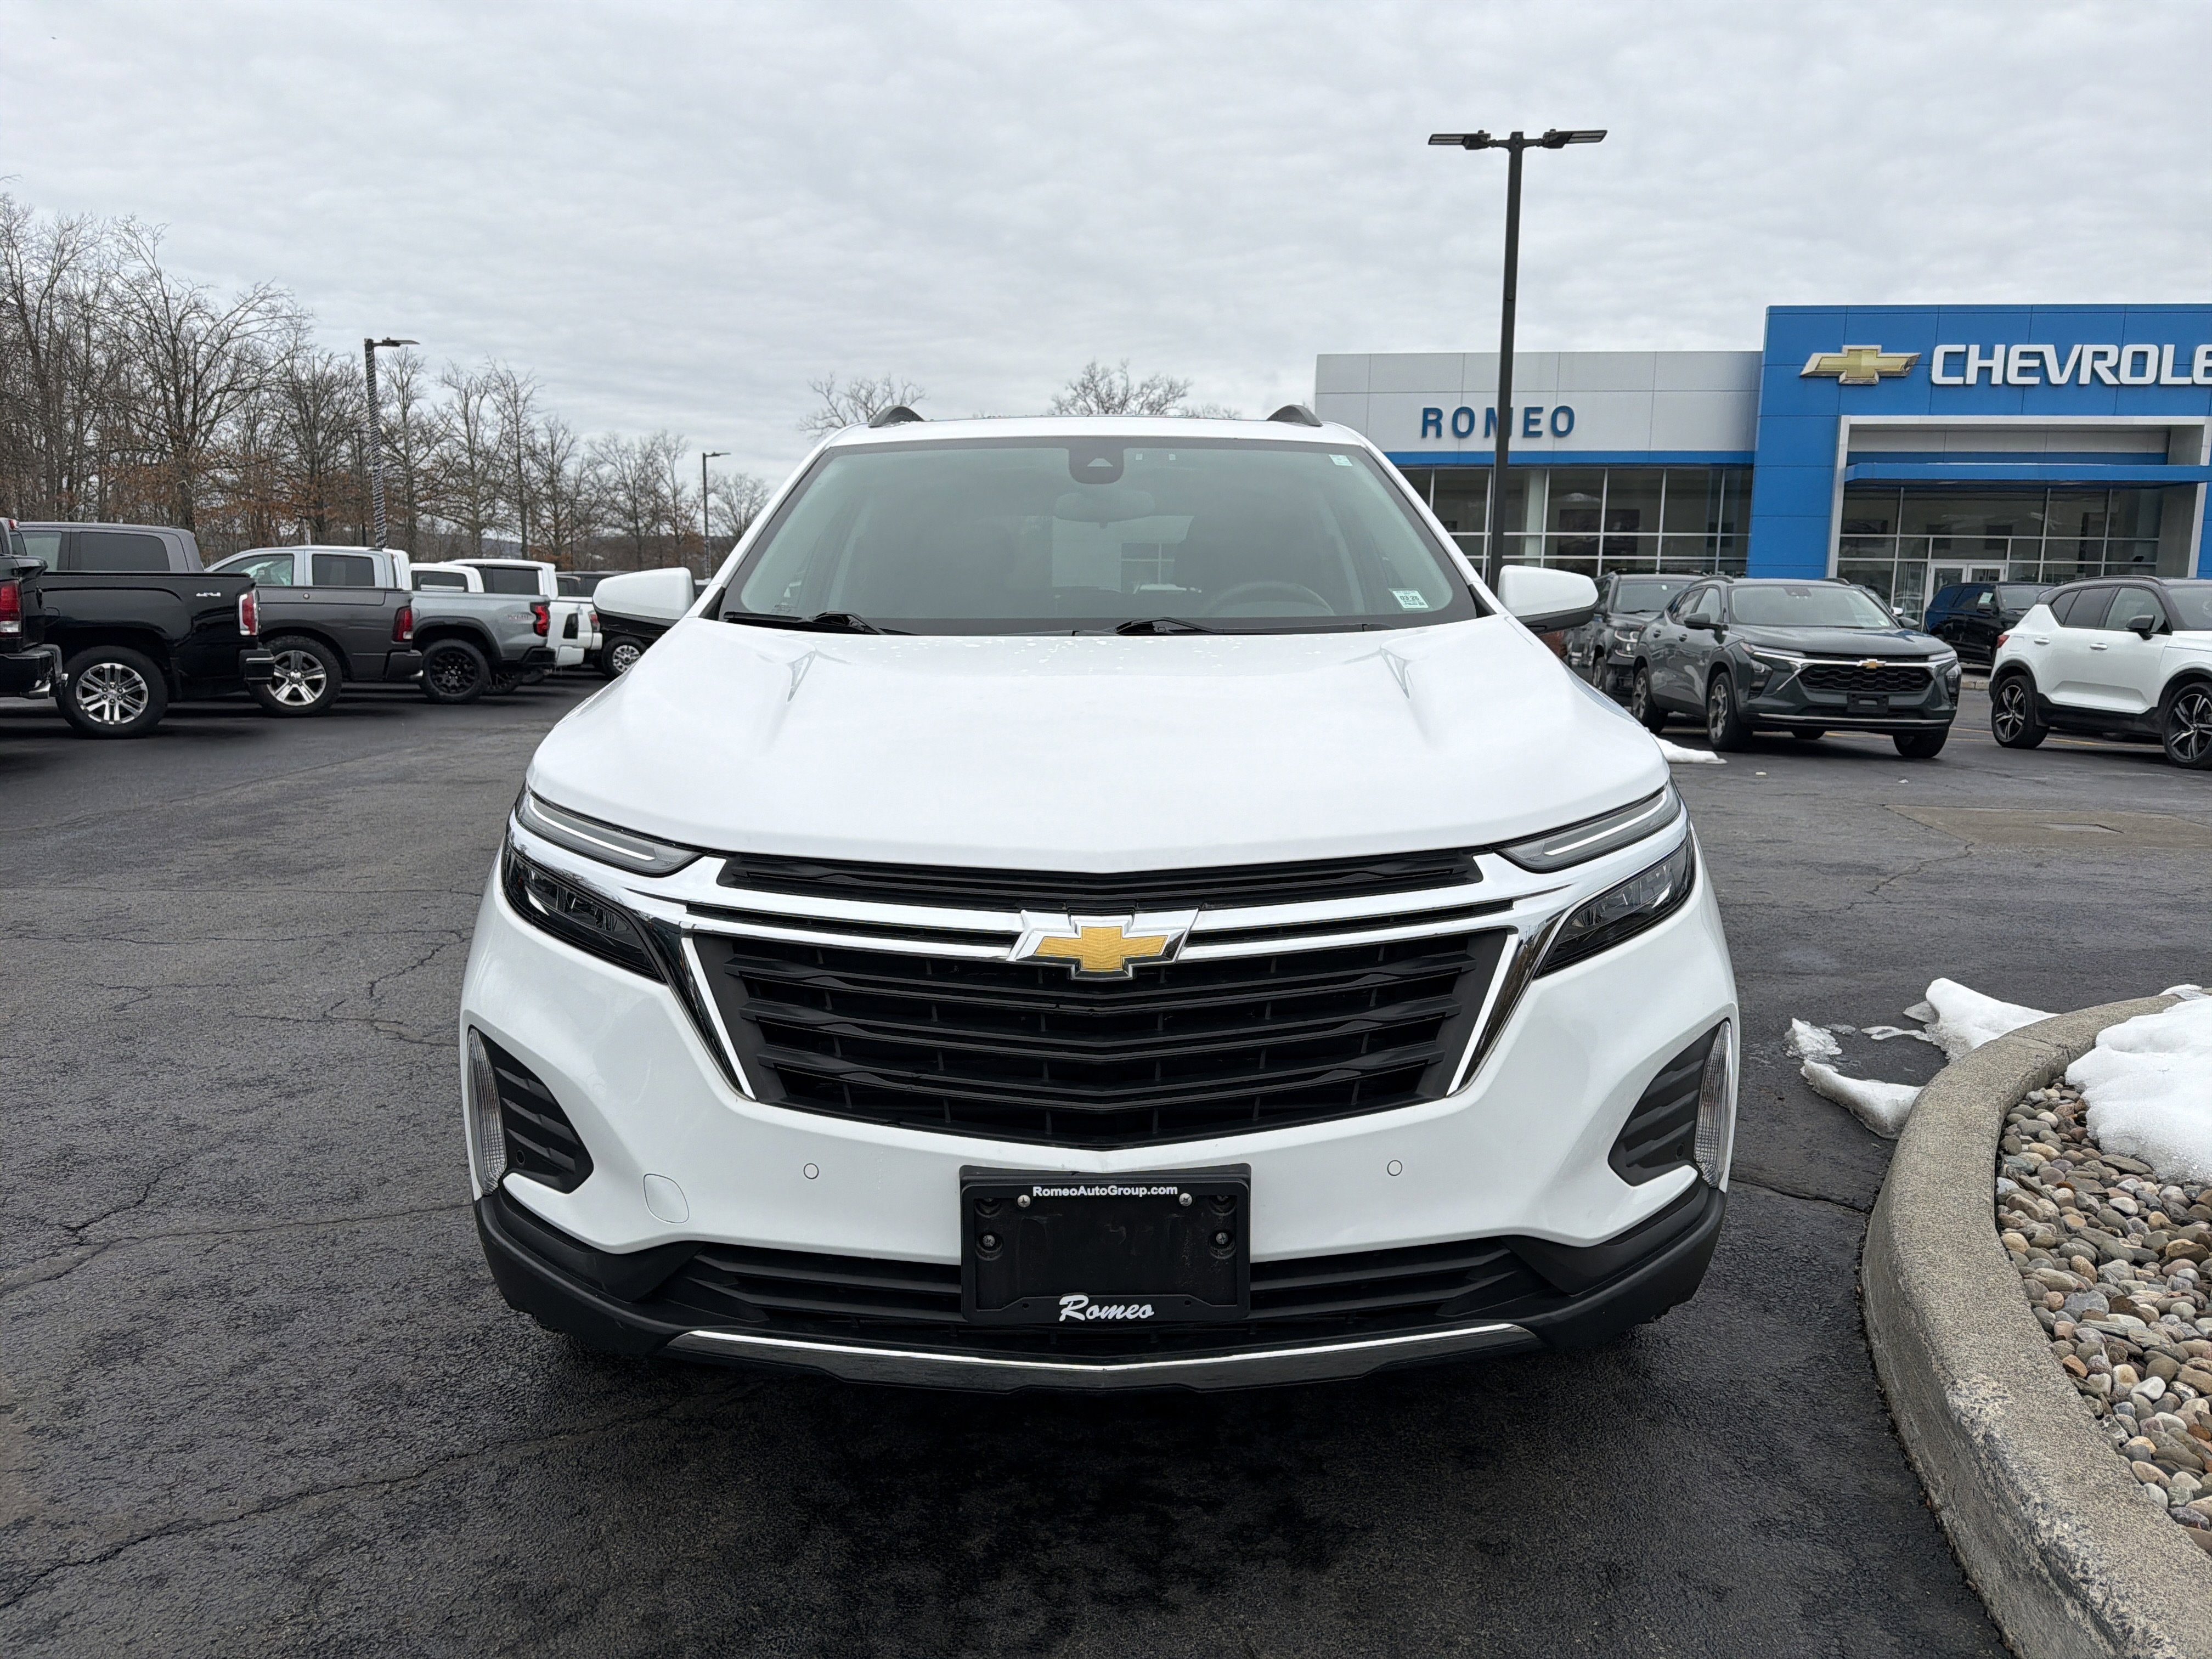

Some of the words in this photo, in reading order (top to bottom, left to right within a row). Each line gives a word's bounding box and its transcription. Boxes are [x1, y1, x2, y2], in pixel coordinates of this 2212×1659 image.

[1421, 405, 1575, 438] ROMEO
[1032, 1185, 1178, 1197] RomeoAutoGroup.com
[1059, 1295, 1155, 1322] Romeo
